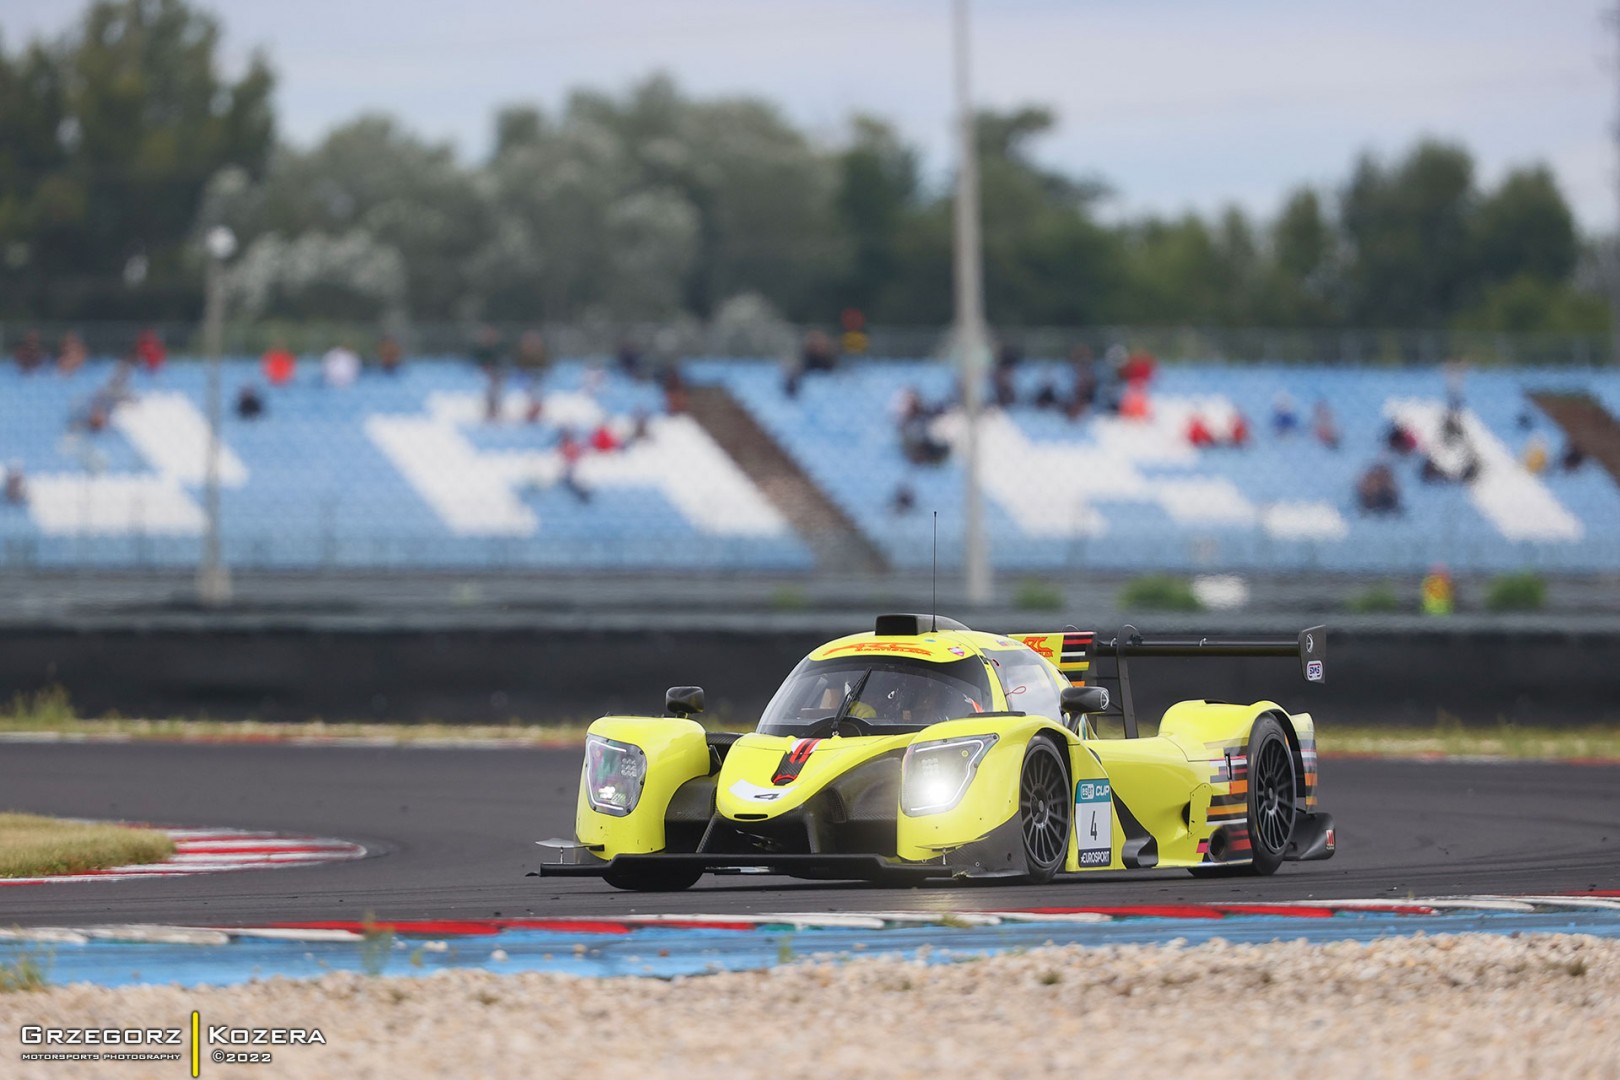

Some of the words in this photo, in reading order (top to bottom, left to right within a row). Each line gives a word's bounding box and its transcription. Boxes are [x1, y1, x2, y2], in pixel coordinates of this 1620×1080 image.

[1096, 785, 1110, 796] CUP
[1090, 810, 1097, 841] 4
[1081, 851, 1110, 863] EUROSPORT
